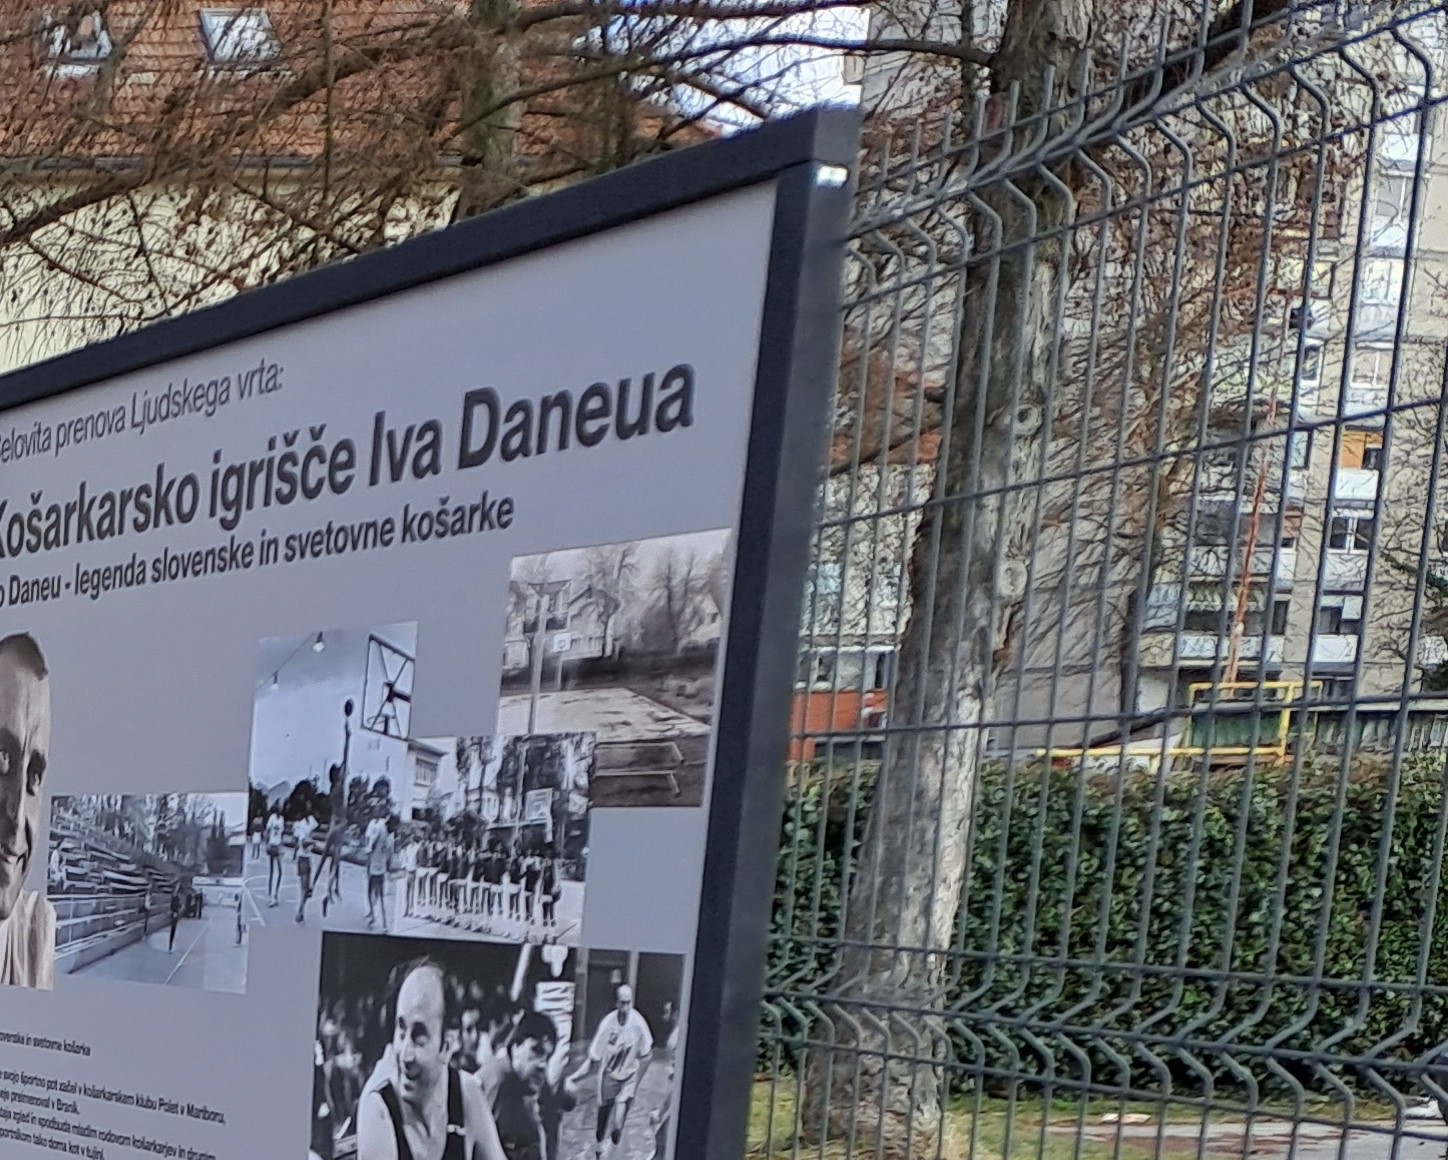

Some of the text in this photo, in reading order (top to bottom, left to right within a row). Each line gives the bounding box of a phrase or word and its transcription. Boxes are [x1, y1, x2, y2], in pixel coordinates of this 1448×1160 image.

[55, 405, 126, 457] prenova
[130, 376, 231, 435] Ljudskega
[237, 357, 284, 400] vrta:
[208, 423, 355, 531] igrišče
[369, 409, 443, 487] Iva
[457, 362, 696, 471] Daneua
[8, 573, 61, 606] Daneu
[74, 552, 146, 600] legenda
[151, 534, 253, 583] slovenske
[259, 528, 278, 566] in
[284, 516, 396, 562] svetovne
[401, 490, 514, 545] košarke
